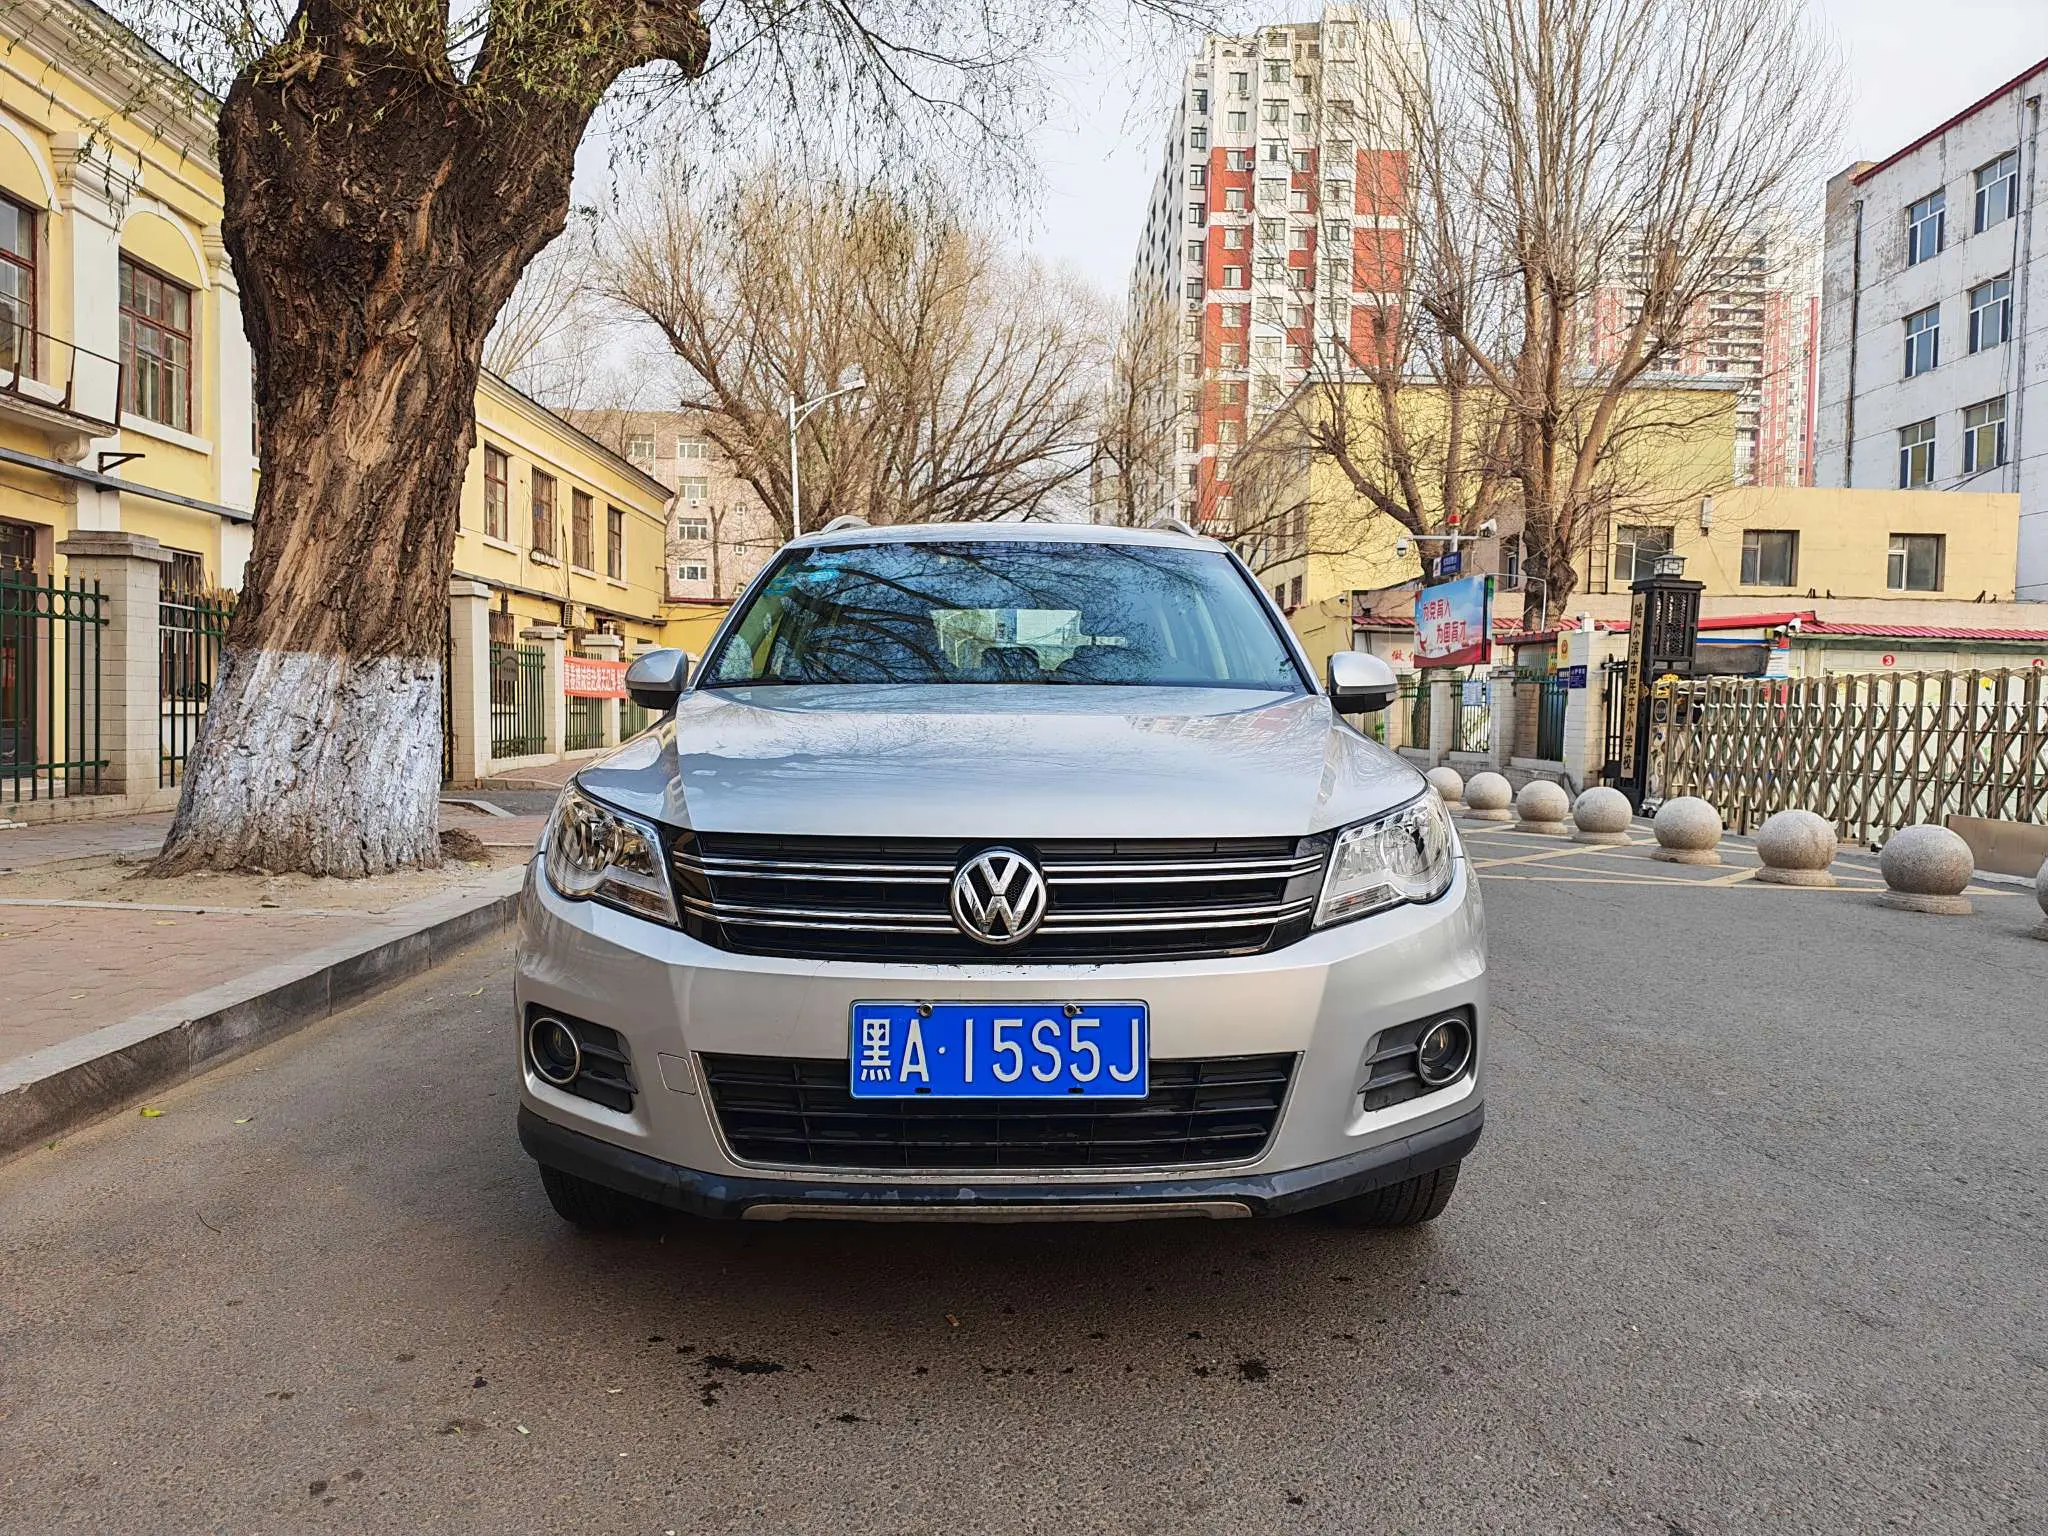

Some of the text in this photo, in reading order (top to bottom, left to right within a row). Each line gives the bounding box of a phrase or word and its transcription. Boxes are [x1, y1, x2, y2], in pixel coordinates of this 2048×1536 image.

[1423, 598, 1452, 621] 为党育人
[1436, 621, 1467, 644] 为国育才
[1622, 602, 1644, 770] 哈尔滨市民乐小学校
